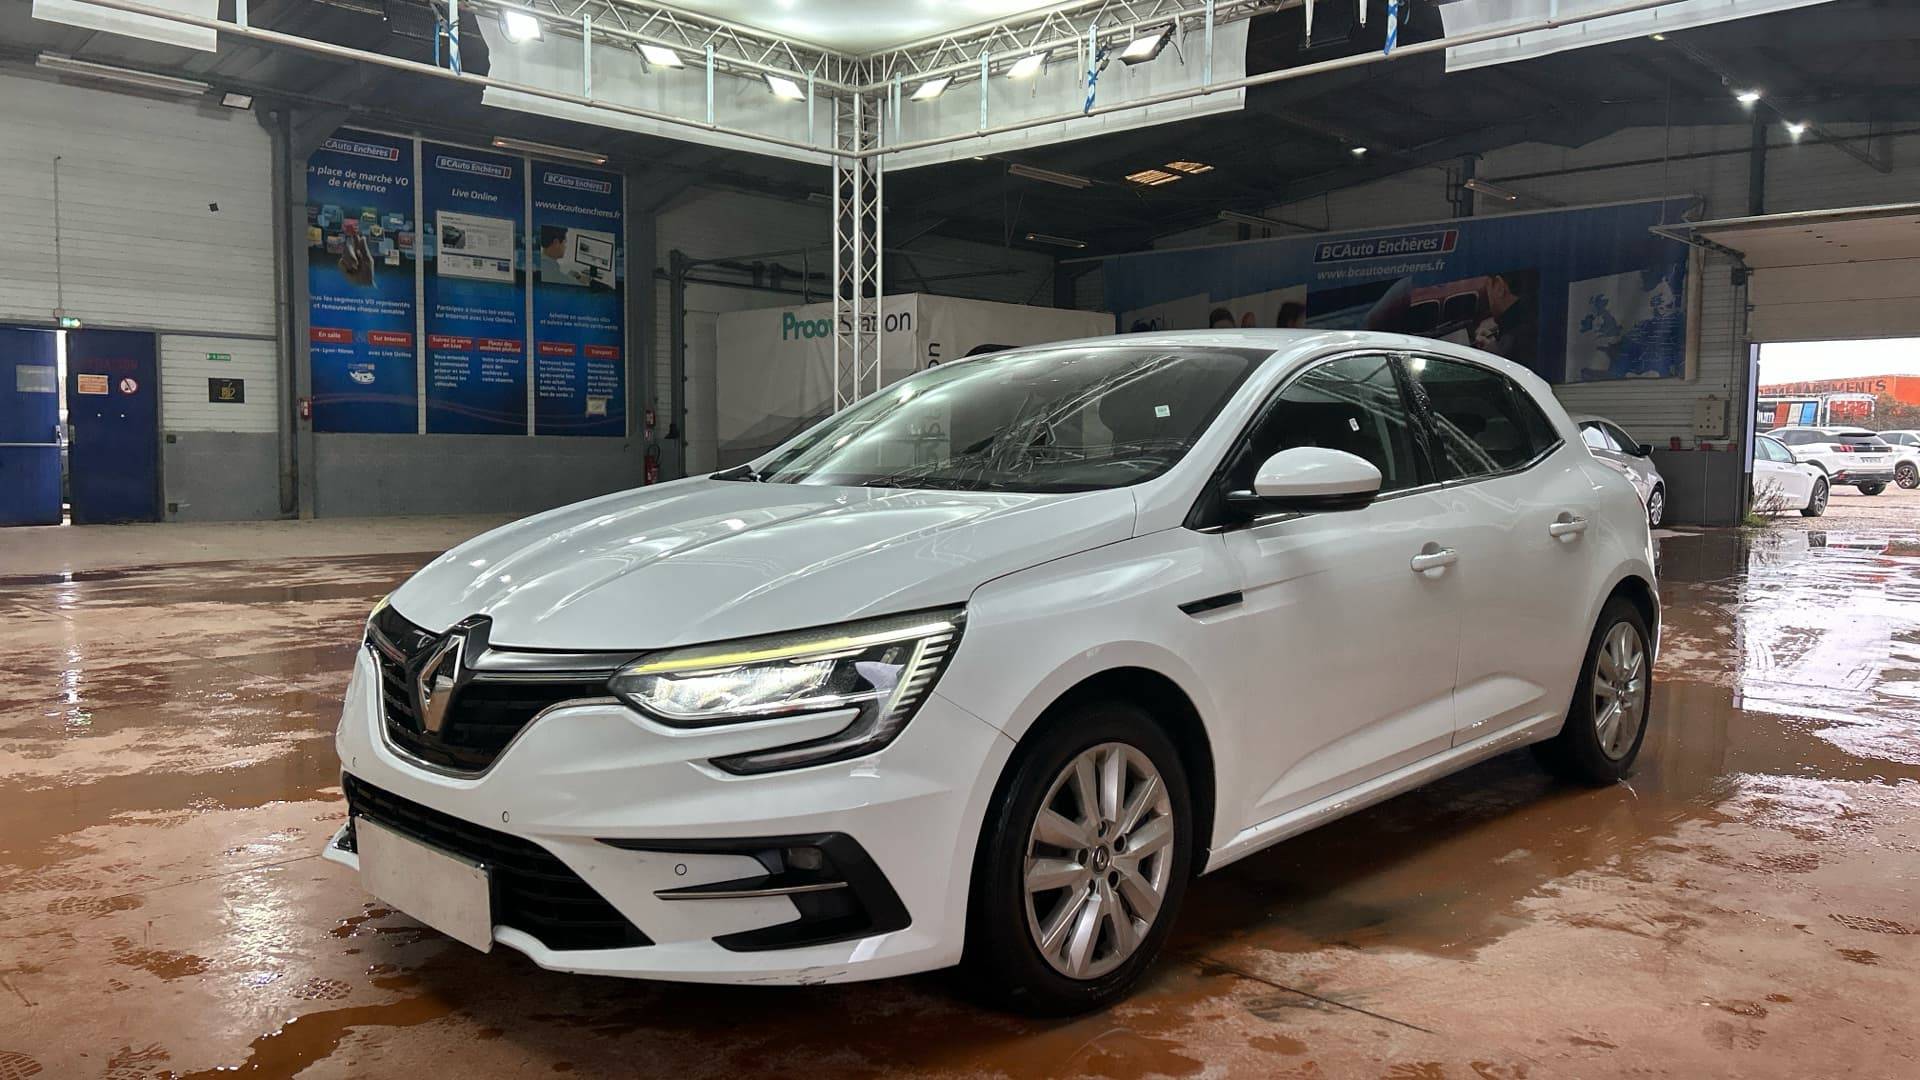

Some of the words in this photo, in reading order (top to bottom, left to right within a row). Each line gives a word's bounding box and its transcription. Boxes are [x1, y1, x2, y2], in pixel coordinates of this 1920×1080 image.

[322, 140, 352, 151] CAuto
[317, 166, 343, 177] place
[345, 169, 357, 179] de
[395, 176, 409, 186] VO
[328, 177, 341, 187] de
[343, 179, 386, 193] référence
[451, 187, 469, 198] Live
[470, 190, 498, 202] Online
[1321, 245, 1374, 259] BCAuto
[1377, 237, 1438, 254] Enchères
[1317, 260, 1446, 280] www.bcautoencheres.fr
